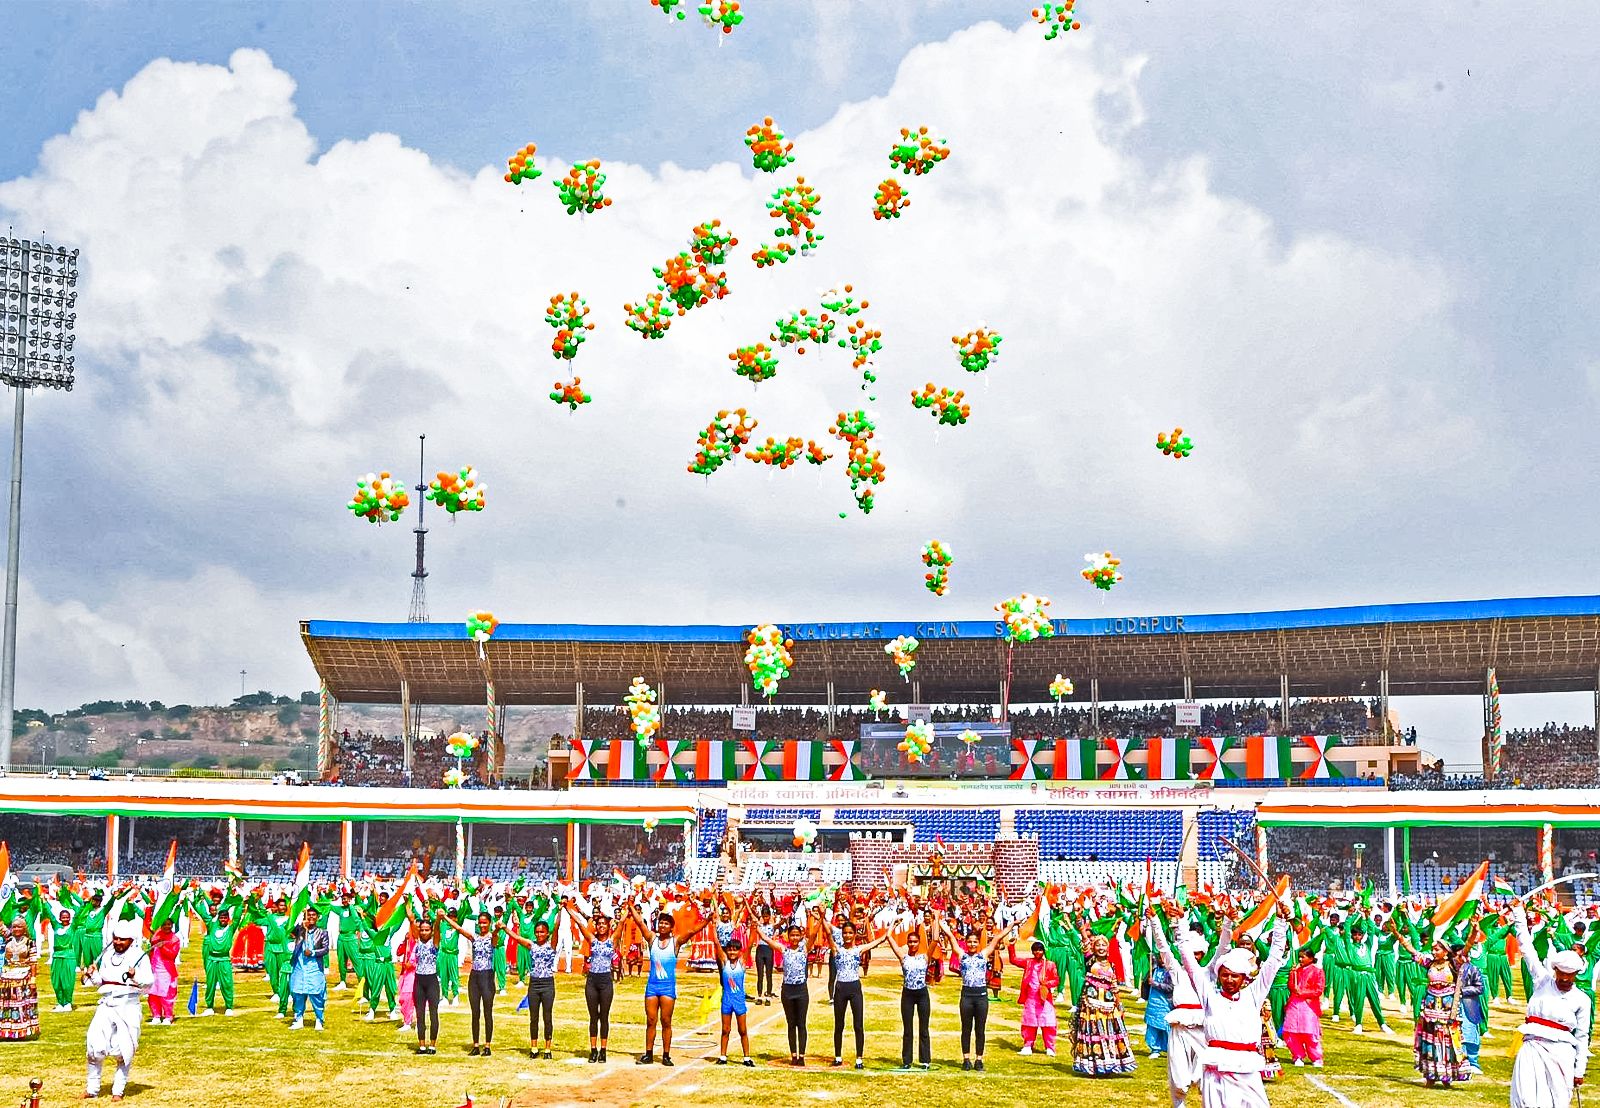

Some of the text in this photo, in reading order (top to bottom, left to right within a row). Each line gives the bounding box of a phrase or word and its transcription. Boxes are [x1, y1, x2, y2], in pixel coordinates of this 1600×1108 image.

[916, 622, 960, 637] KHAN
[1104, 616, 1186, 633] JODHPUR
[1050, 786, 1089, 800] हार्दिक
